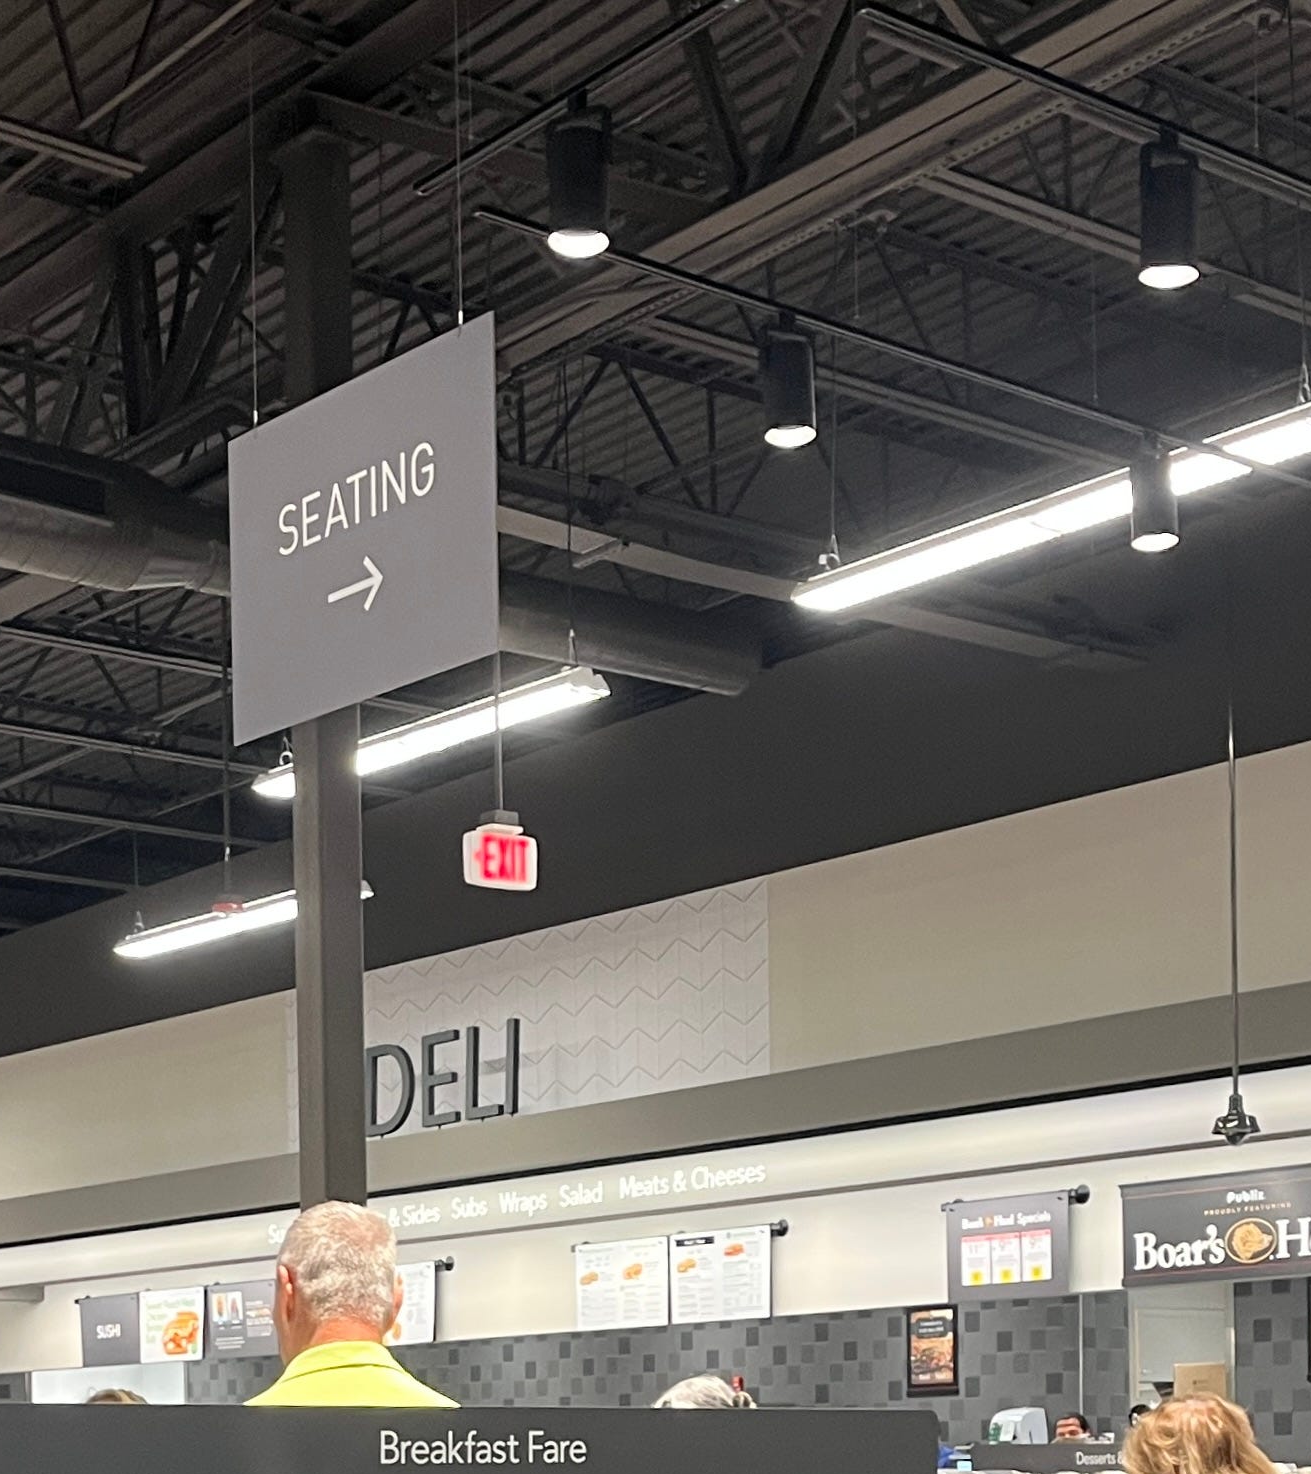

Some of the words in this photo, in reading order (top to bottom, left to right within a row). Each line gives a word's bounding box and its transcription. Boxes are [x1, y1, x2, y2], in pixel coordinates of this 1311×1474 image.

[279, 442, 435, 556] SEATING
[483, 836, 527, 882] EXIT
[365, 1018, 520, 1137] DELI
[388, 1208, 400, 1227] &
[402, 1203, 441, 1226] Sides
[451, 1196, 488, 1219] Subs
[498, 1191, 547, 1217] Wraps
[559, 1180, 603, 1208] Salad
[619, 1175, 670, 1199] Meats
[673, 1170, 687, 1193] &
[691, 1164, 766, 1190] Cheeses
[1226, 1189, 1266, 1204] Publix
[1133, 1224, 1225, 1270] Boar's
[96, 1323, 121, 1339] SUSHI
[379, 1429, 520, 1465] Breakfast
[527, 1430, 587, 1464] Fare
[1076, 1451, 1115, 1466] Desserts
